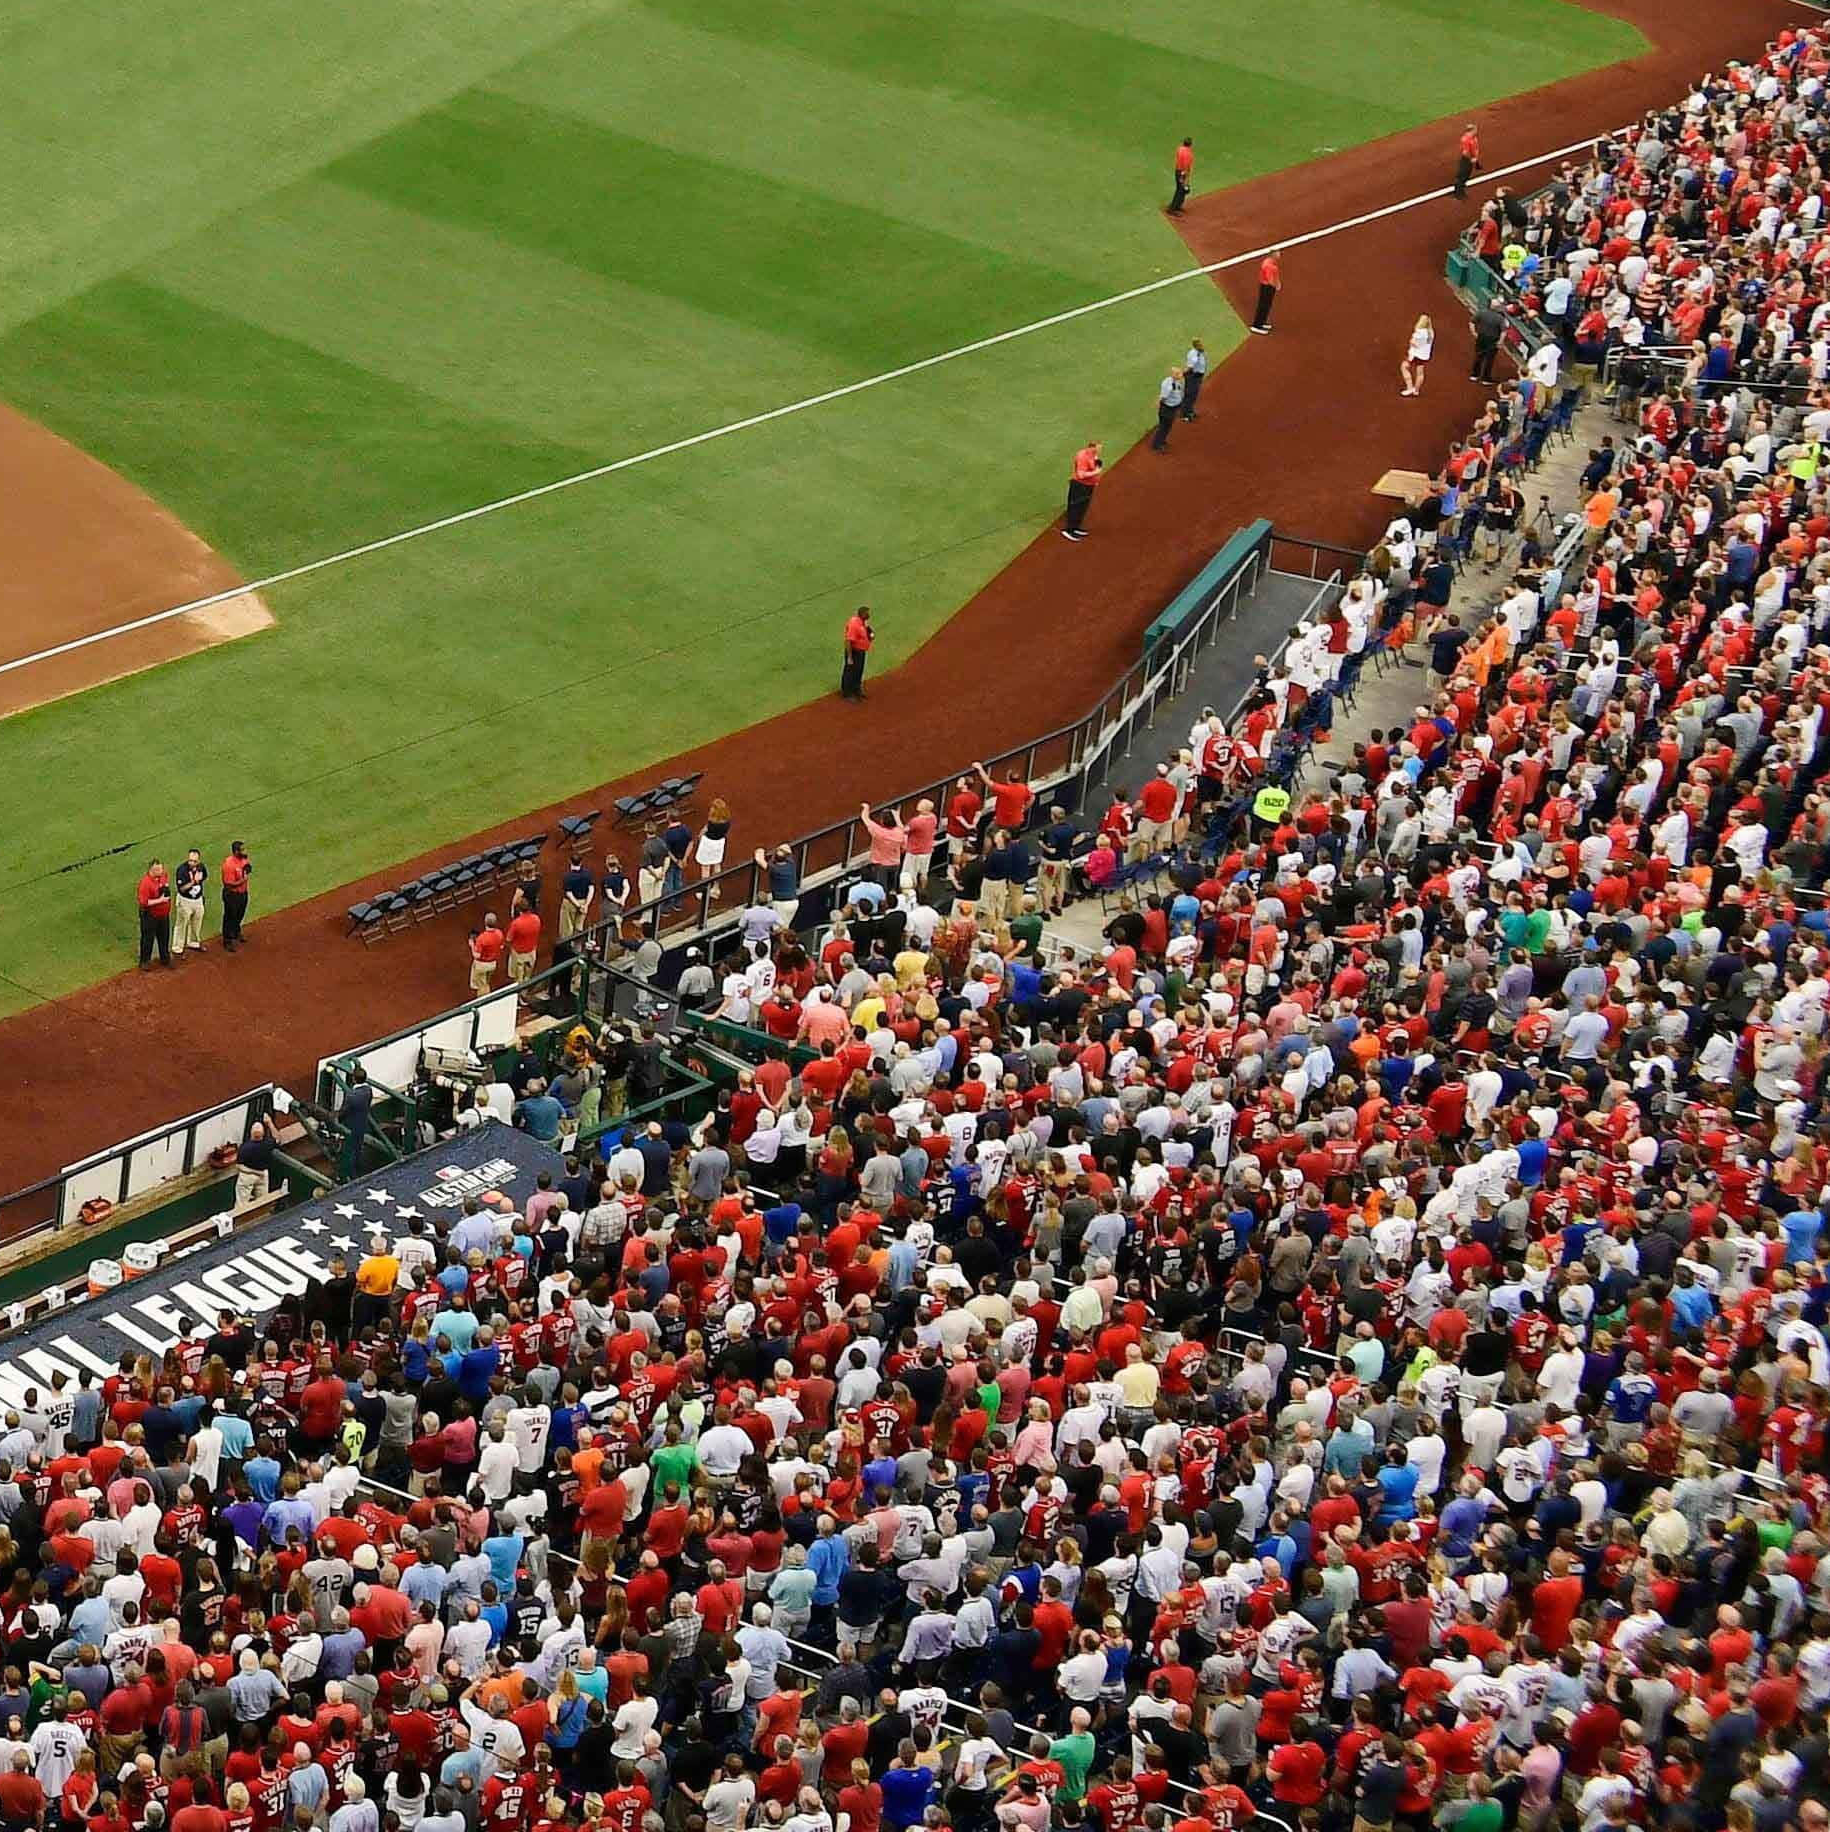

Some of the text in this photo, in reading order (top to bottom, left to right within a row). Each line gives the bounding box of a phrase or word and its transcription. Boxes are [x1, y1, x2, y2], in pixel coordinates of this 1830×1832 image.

[103, 1235, 336, 1358] LEAGUE
[49, 1410, 73, 1429] 45
[317, 1574, 344, 1593] 42
